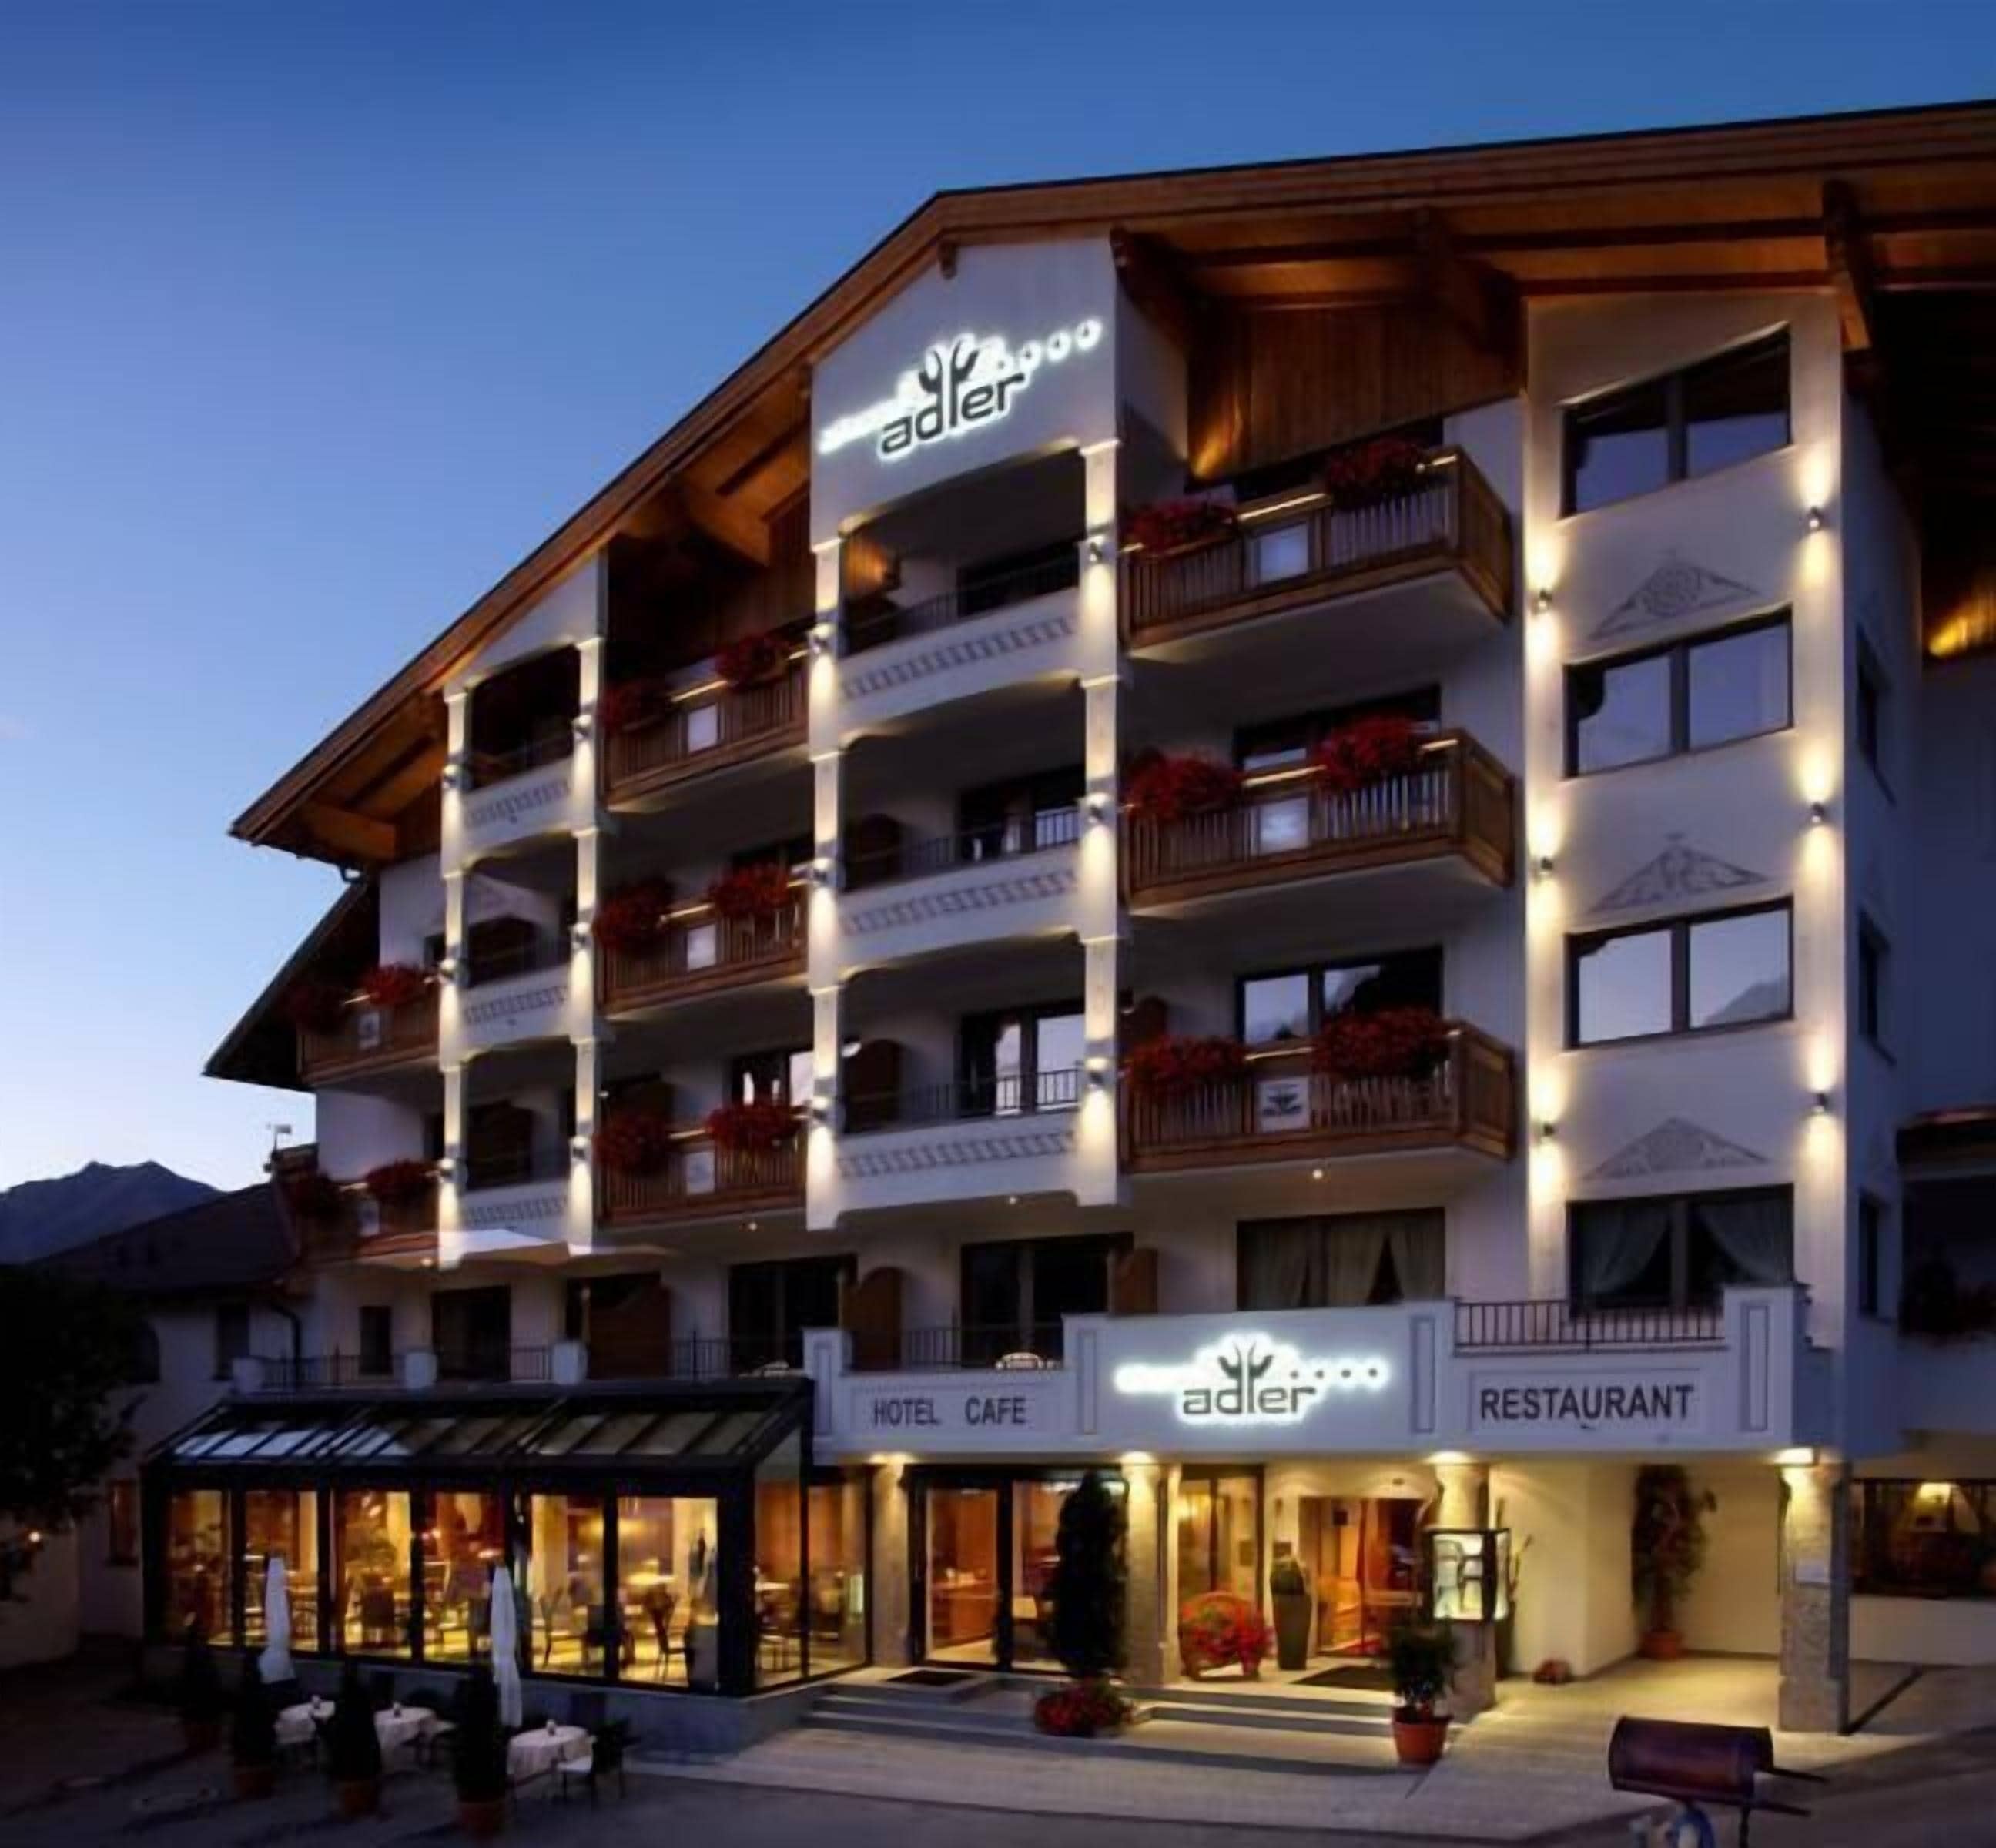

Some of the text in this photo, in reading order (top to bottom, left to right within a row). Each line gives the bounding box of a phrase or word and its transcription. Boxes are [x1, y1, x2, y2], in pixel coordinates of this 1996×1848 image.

[880, 356, 1026, 454] adler
[873, 1396, 1026, 1424] HOTEL CAFE
[1183, 1368, 1316, 1415] adler
[1480, 1384, 1695, 1420] RESTAURANT
